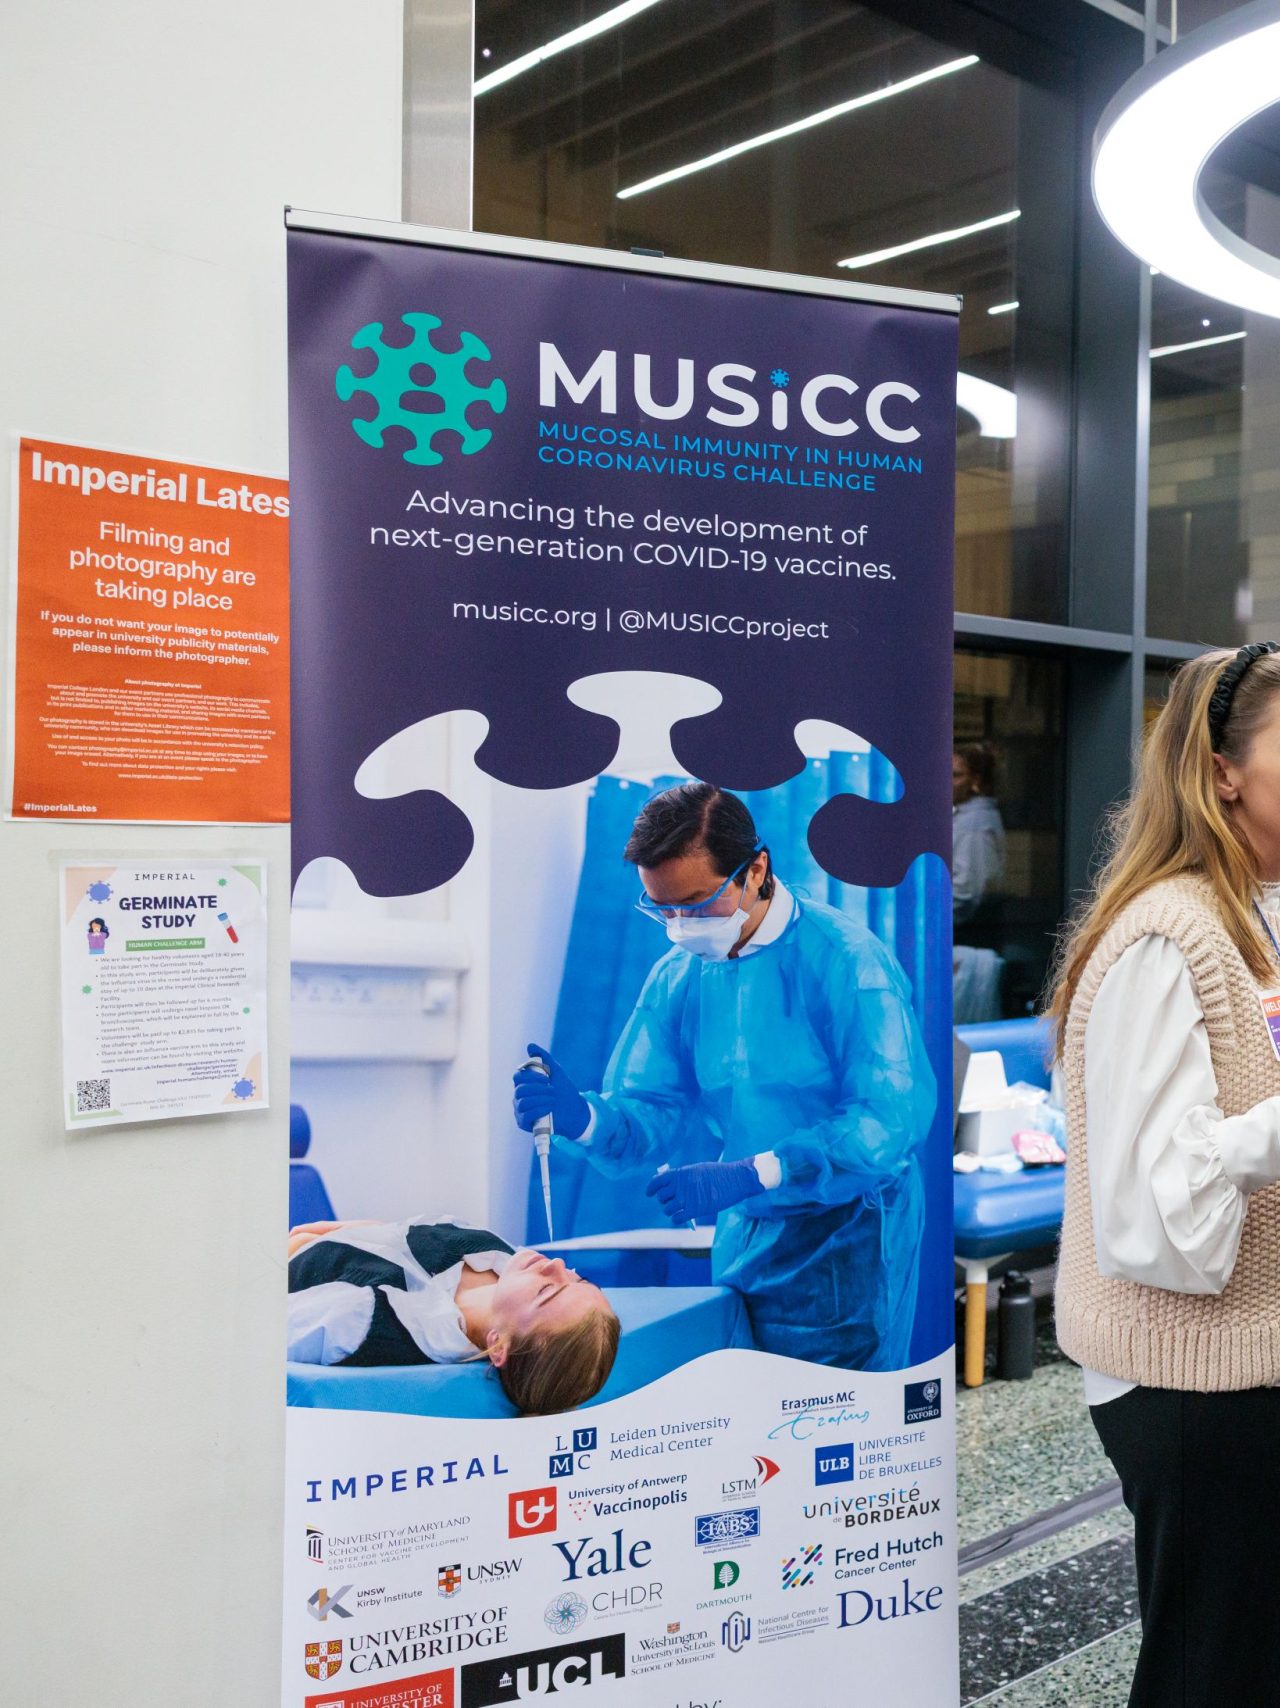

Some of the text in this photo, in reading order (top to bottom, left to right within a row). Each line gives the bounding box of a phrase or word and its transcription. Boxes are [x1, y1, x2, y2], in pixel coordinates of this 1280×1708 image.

[538, 421, 923, 475] MUCOSAL IMMUNITY IN HUMAN
[538, 445, 877, 492] CORONAVIRUS CHALLENGE
[32, 451, 289, 518] Imperial Lates
[405, 489, 869, 546] Advancing the development of
[99, 520, 230, 556] Filming and
[370, 526, 897, 581] next-generation COVID-19 vaccines.
[69, 547, 257, 587] photography are
[95, 577, 233, 612] taking place
[41, 610, 280, 645] If you do not want your image to potentially
[452, 601, 597, 631] musicc.org
[619, 610, 830, 641] @MUSICCproject
[52, 626, 270, 656] appear in university publicity materials,
[72, 641, 252, 667] please inform the photographer.
[23, 803, 97, 813] #ImperialLates
[134, 873, 196, 881] IMPERIAL
[119, 895, 217, 911] GERMINATE
[142, 914, 196, 928] STUDY
[781, 1394, 834, 1410] Erasmus
[836, 1391, 856, 1402] MC
[907, 1409, 939, 1422] OXFORD
[610, 1417, 731, 1444] Leiden University
[859, 1431, 926, 1451] UNIVERSITÉ
[609, 1436, 714, 1462] Medical Center
[859, 1452, 892, 1466] LIBRE
[306, 1454, 509, 1502] IMPERIAL
[819, 1457, 850, 1474] ULB
[859, 1456, 943, 1480] DE BRUXELLES
[568, 1474, 688, 1500] University of Antwerp
[722, 1478, 757, 1494] LSTM
[593, 1489, 688, 1518] Vaccinopolis
[802, 1481, 921, 1520] université
[845, 1498, 941, 1528] BORDEAUX
[328, 1530, 397, 1547] UNIVERSITY
[407, 1515, 471, 1535] MARYLAND
[709, 1517, 751, 1535] IABS
[328, 1533, 437, 1557] SCHOOL OF MEDICINE
[328, 1556, 358, 1565] CENTER
[380, 1547, 413, 1558] VACCINE
[415, 1536, 470, 1551] DEVELOPMENT
[552, 1529, 652, 1582] Yale
[835, 1531, 943, 1566] Fred Hutch
[347, 1561, 377, 1569] GLOBAL
[381, 1554, 411, 1563] HEALTH
[467, 1558, 523, 1581] UNSW
[834, 1558, 917, 1580] Cancer Center
[479, 1574, 512, 1584] SYDNEY
[357, 1587, 386, 1598] UNSW
[357, 1590, 423, 1608] Kirby Institute
[592, 1582, 663, 1612] CHDR
[696, 1594, 752, 1610] DARTMOUTH
[836, 1578, 943, 1629] Duke
[758, 1605, 829, 1626] National Centre for
[758, 1615, 829, 1635] Infectious Diseases
[349, 1606, 508, 1652] UNIVERSITY OF
[640, 1630, 708, 1651] Washington
[349, 1625, 509, 1674] CAMBRIDGE
[631, 1650, 673, 1663] University
[516, 1652, 617, 1701] UCL
[631, 1665, 661, 1675] SCHOOL
[676, 1653, 715, 1666] MEDICINE
[351, 1683, 442, 1708] UNIVERSITY OF
